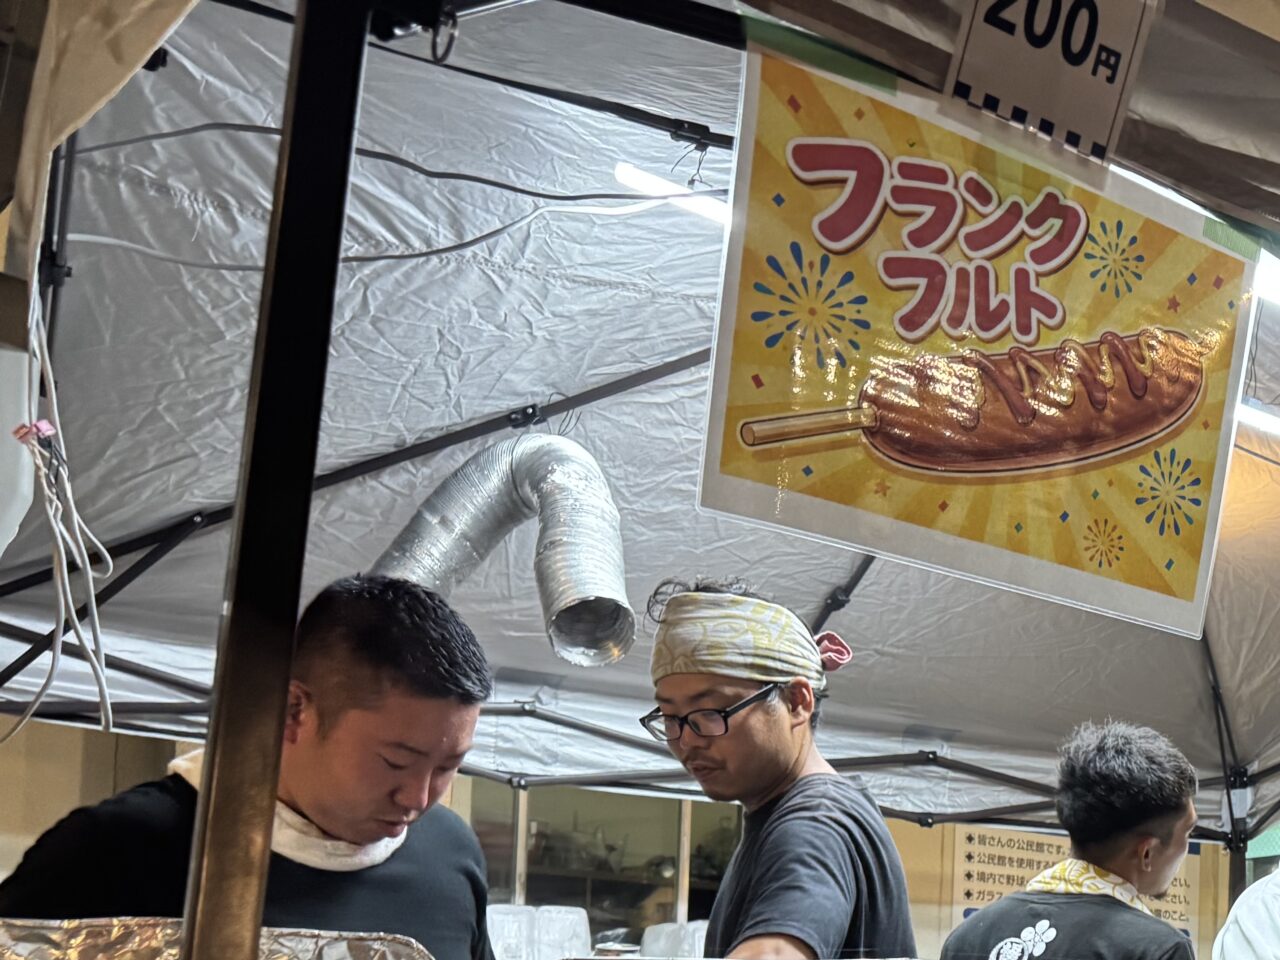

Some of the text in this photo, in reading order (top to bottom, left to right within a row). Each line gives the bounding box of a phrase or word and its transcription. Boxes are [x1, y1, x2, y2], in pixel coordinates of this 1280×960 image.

[786, 137, 1088, 273] フランク
[877, 250, 1065, 345] フルト
[976, 870, 1029, 887] 境内で野球
